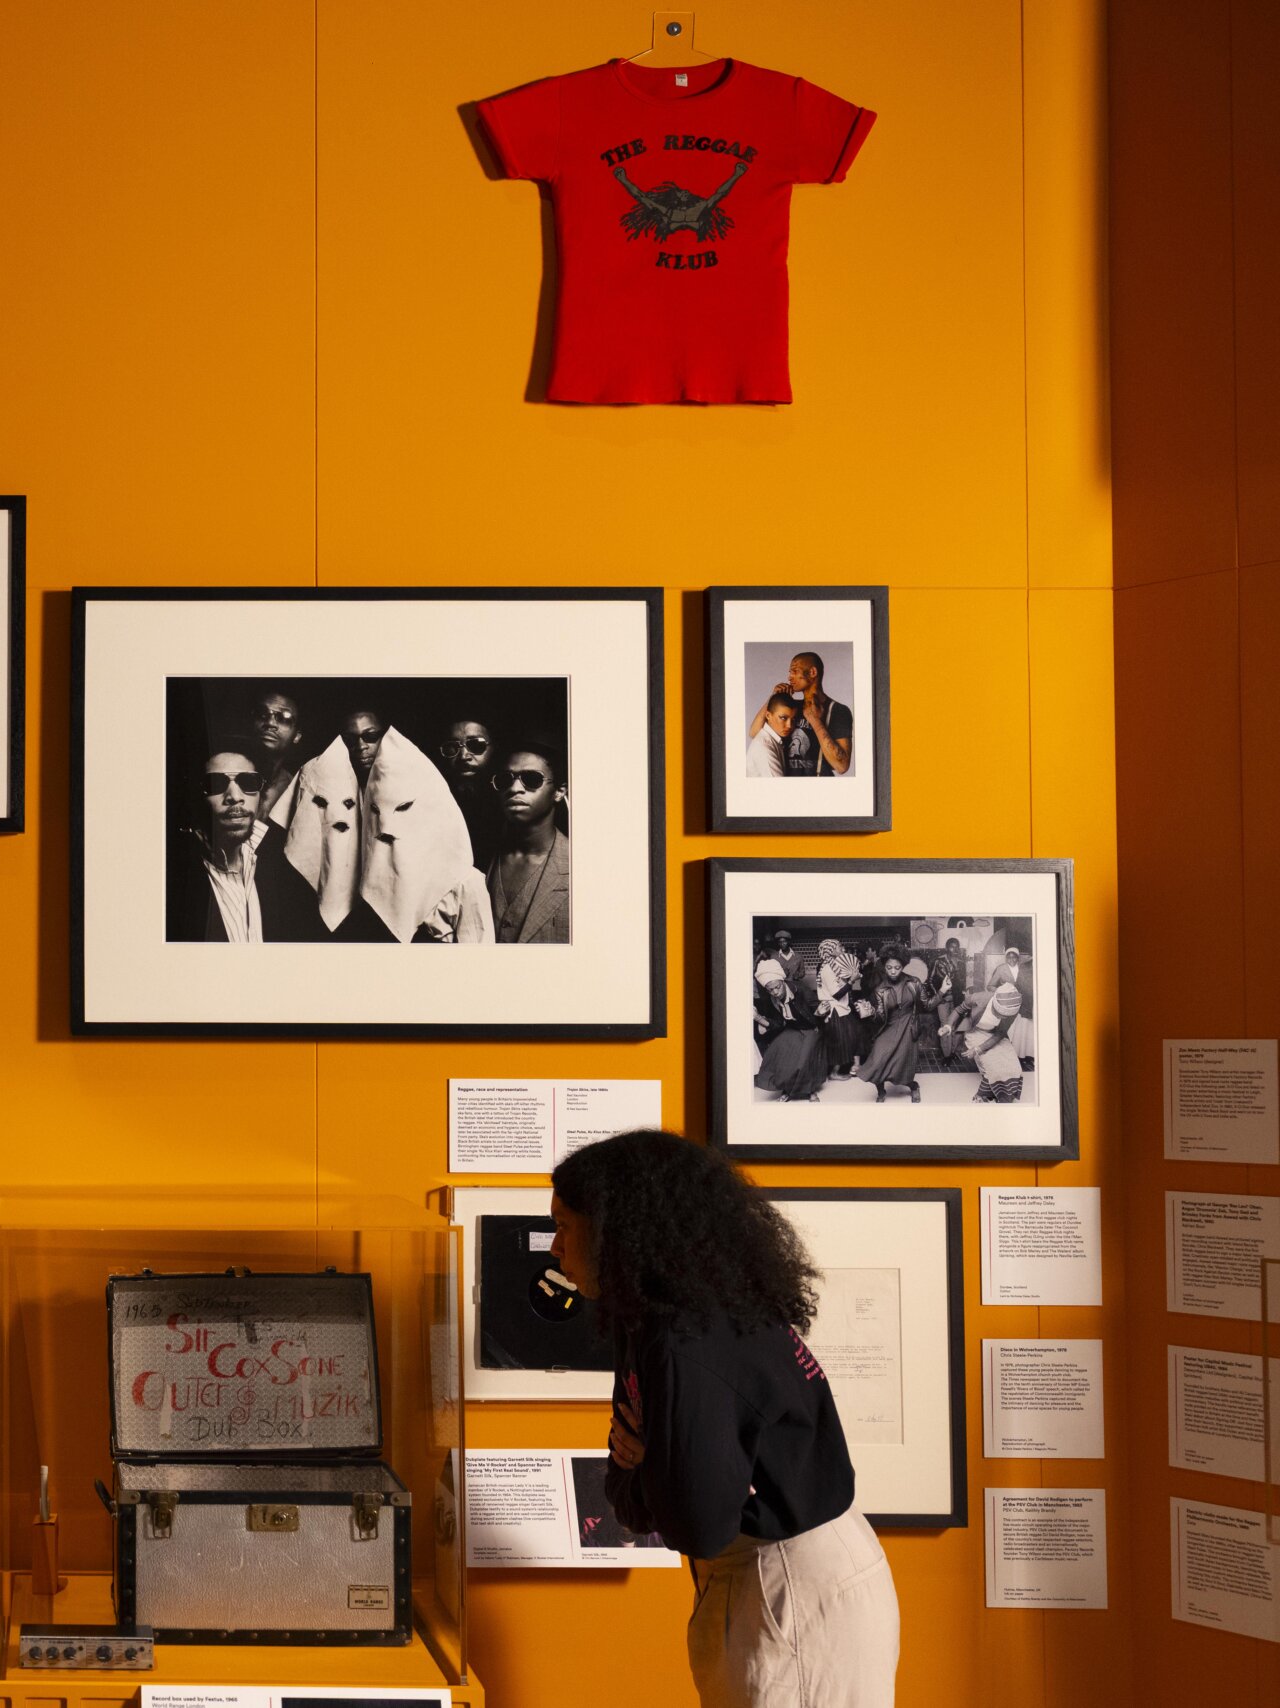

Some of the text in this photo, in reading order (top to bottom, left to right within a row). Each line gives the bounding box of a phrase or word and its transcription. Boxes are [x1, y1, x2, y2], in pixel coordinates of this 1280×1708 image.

[600, 134, 758, 167] THE REGGAE
[656, 250, 718, 270] KLUB
[165, 1312, 216, 1354] Sir
